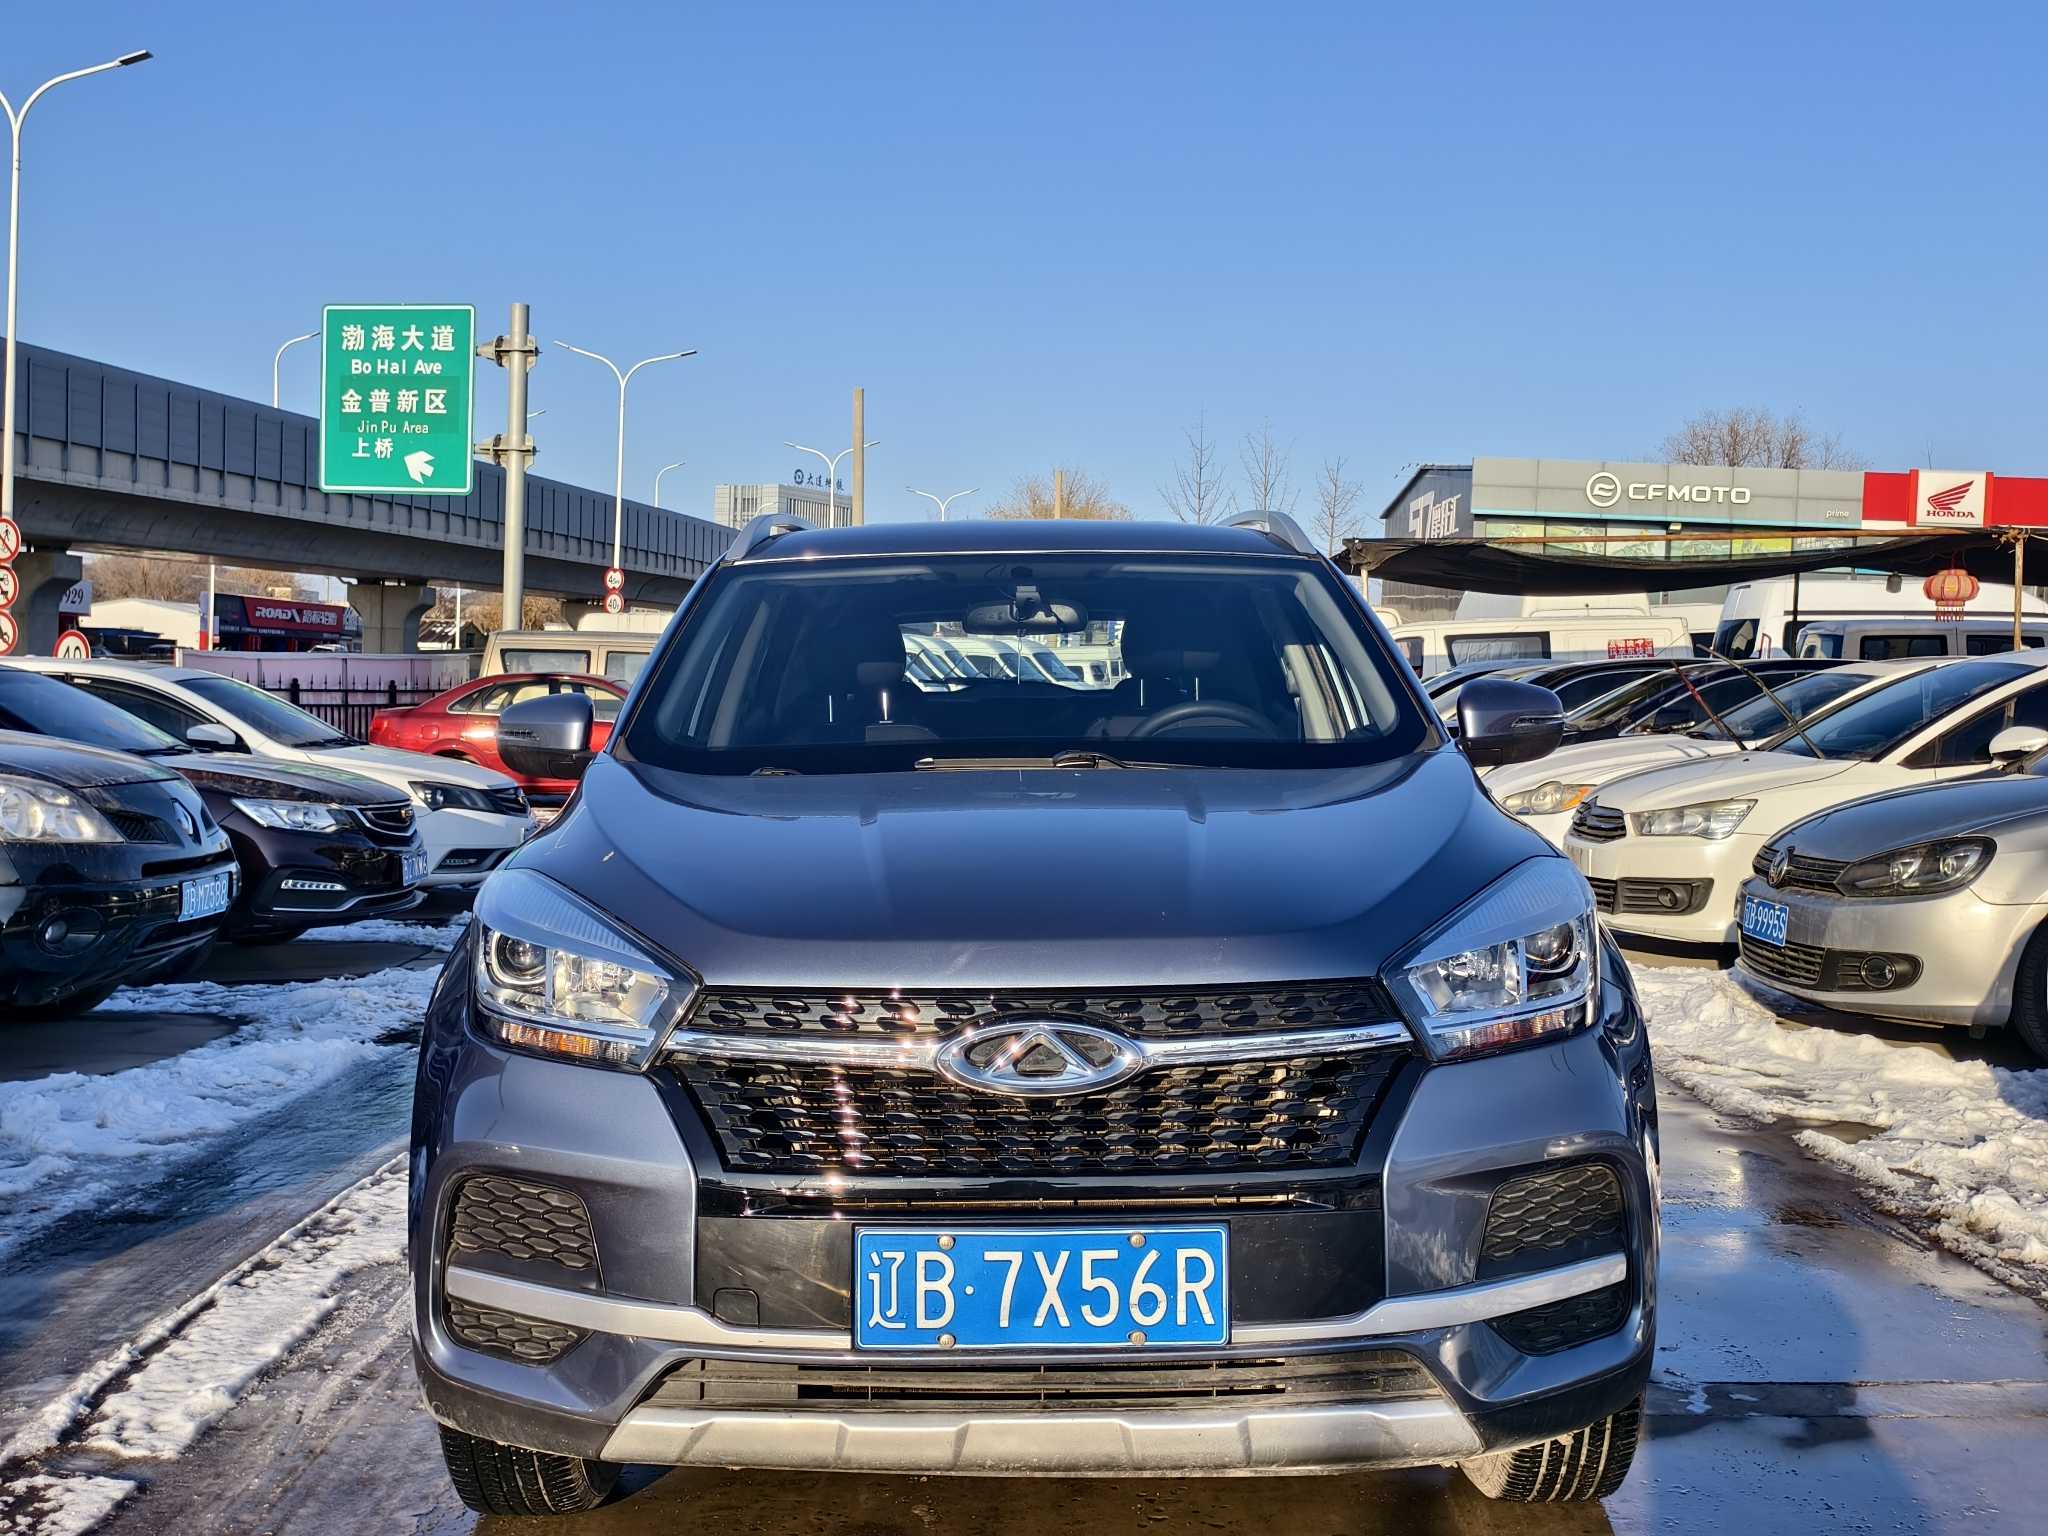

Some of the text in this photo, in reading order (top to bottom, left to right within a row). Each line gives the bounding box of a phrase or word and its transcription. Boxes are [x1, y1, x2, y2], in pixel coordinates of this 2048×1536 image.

[341, 324, 455, 351] 渤海大道
[351, 358, 372, 374] Bo
[414, 359, 442, 375] Ave
[341, 388, 448, 414] 金普新区
[358, 420, 429, 434] Jin Pu Area
[352, 437, 394, 459] 上桥
[1628, 483, 1751, 504] CFMOTO
[1925, 510, 1976, 518] HONDA
